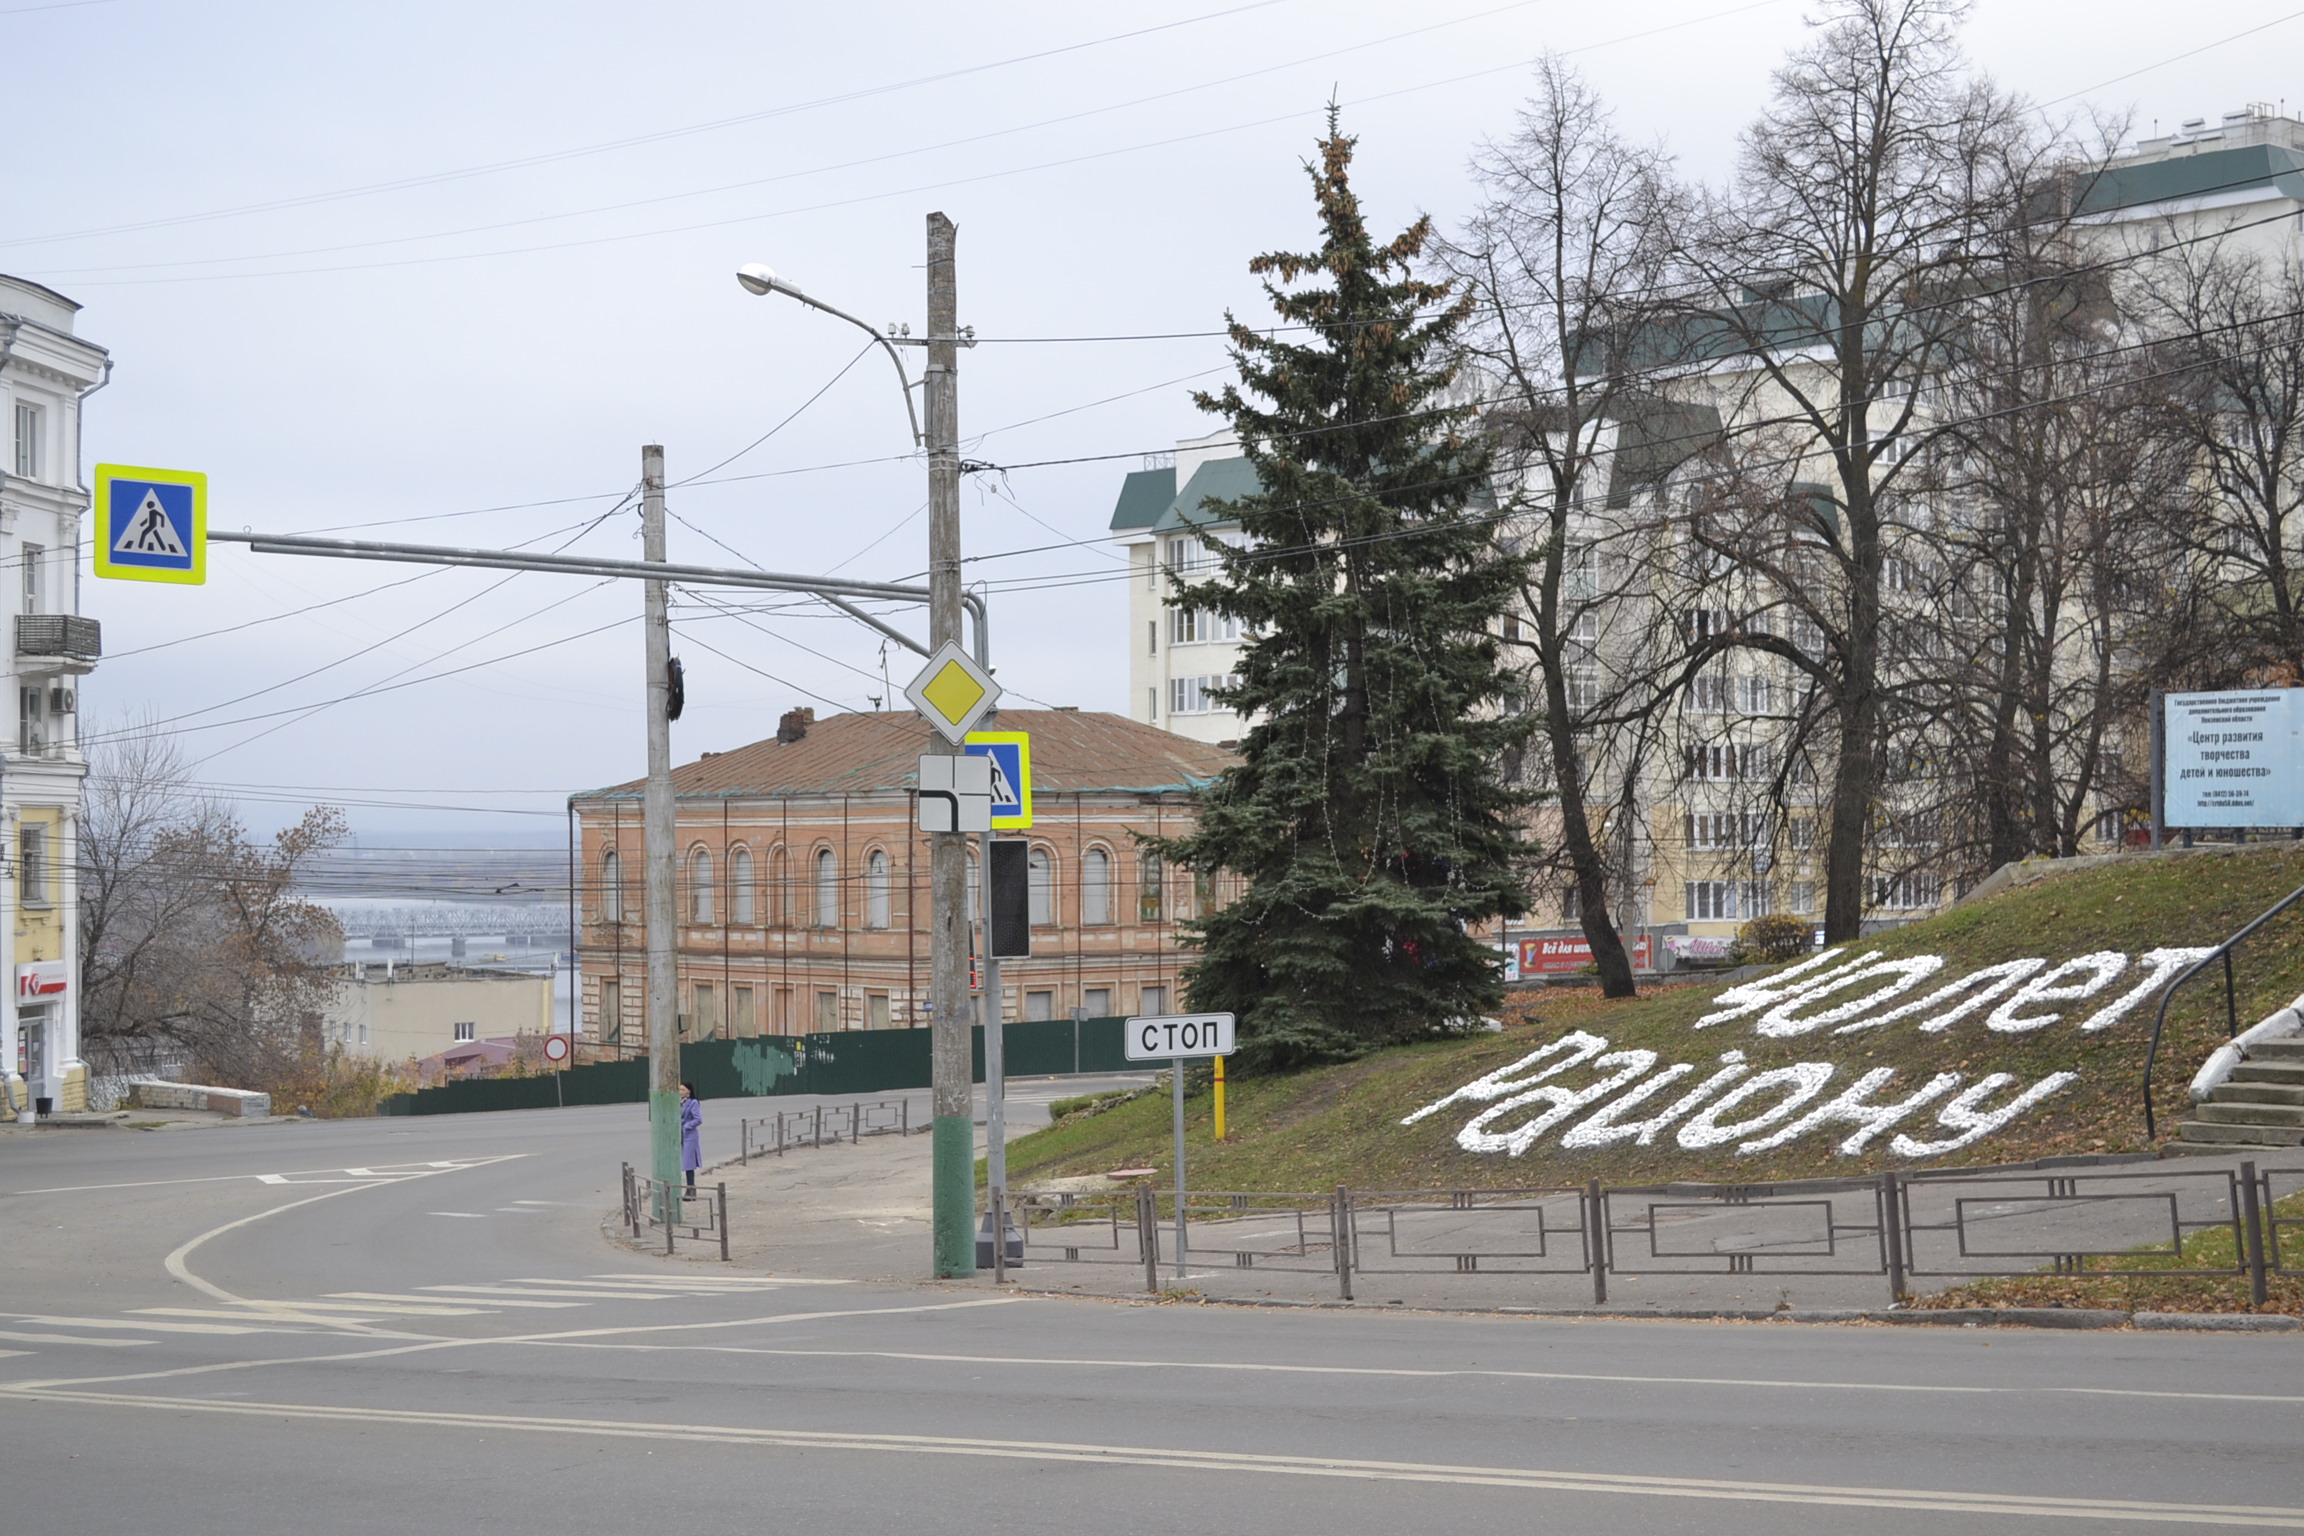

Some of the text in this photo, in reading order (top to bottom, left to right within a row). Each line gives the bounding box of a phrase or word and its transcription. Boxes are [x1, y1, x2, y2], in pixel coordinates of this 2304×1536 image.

[2187, 730, 2264, 746] «Центр развития
[2200, 750, 2250, 763] творчества
[2180, 766, 2271, 780] детей и юношества»
[1542, 941, 1558, 954] Всё
[1558, 940, 1573, 954] для
[1694, 946, 2224, 1038] 40 лет
[1141, 1021, 1218, 1052] СТОП
